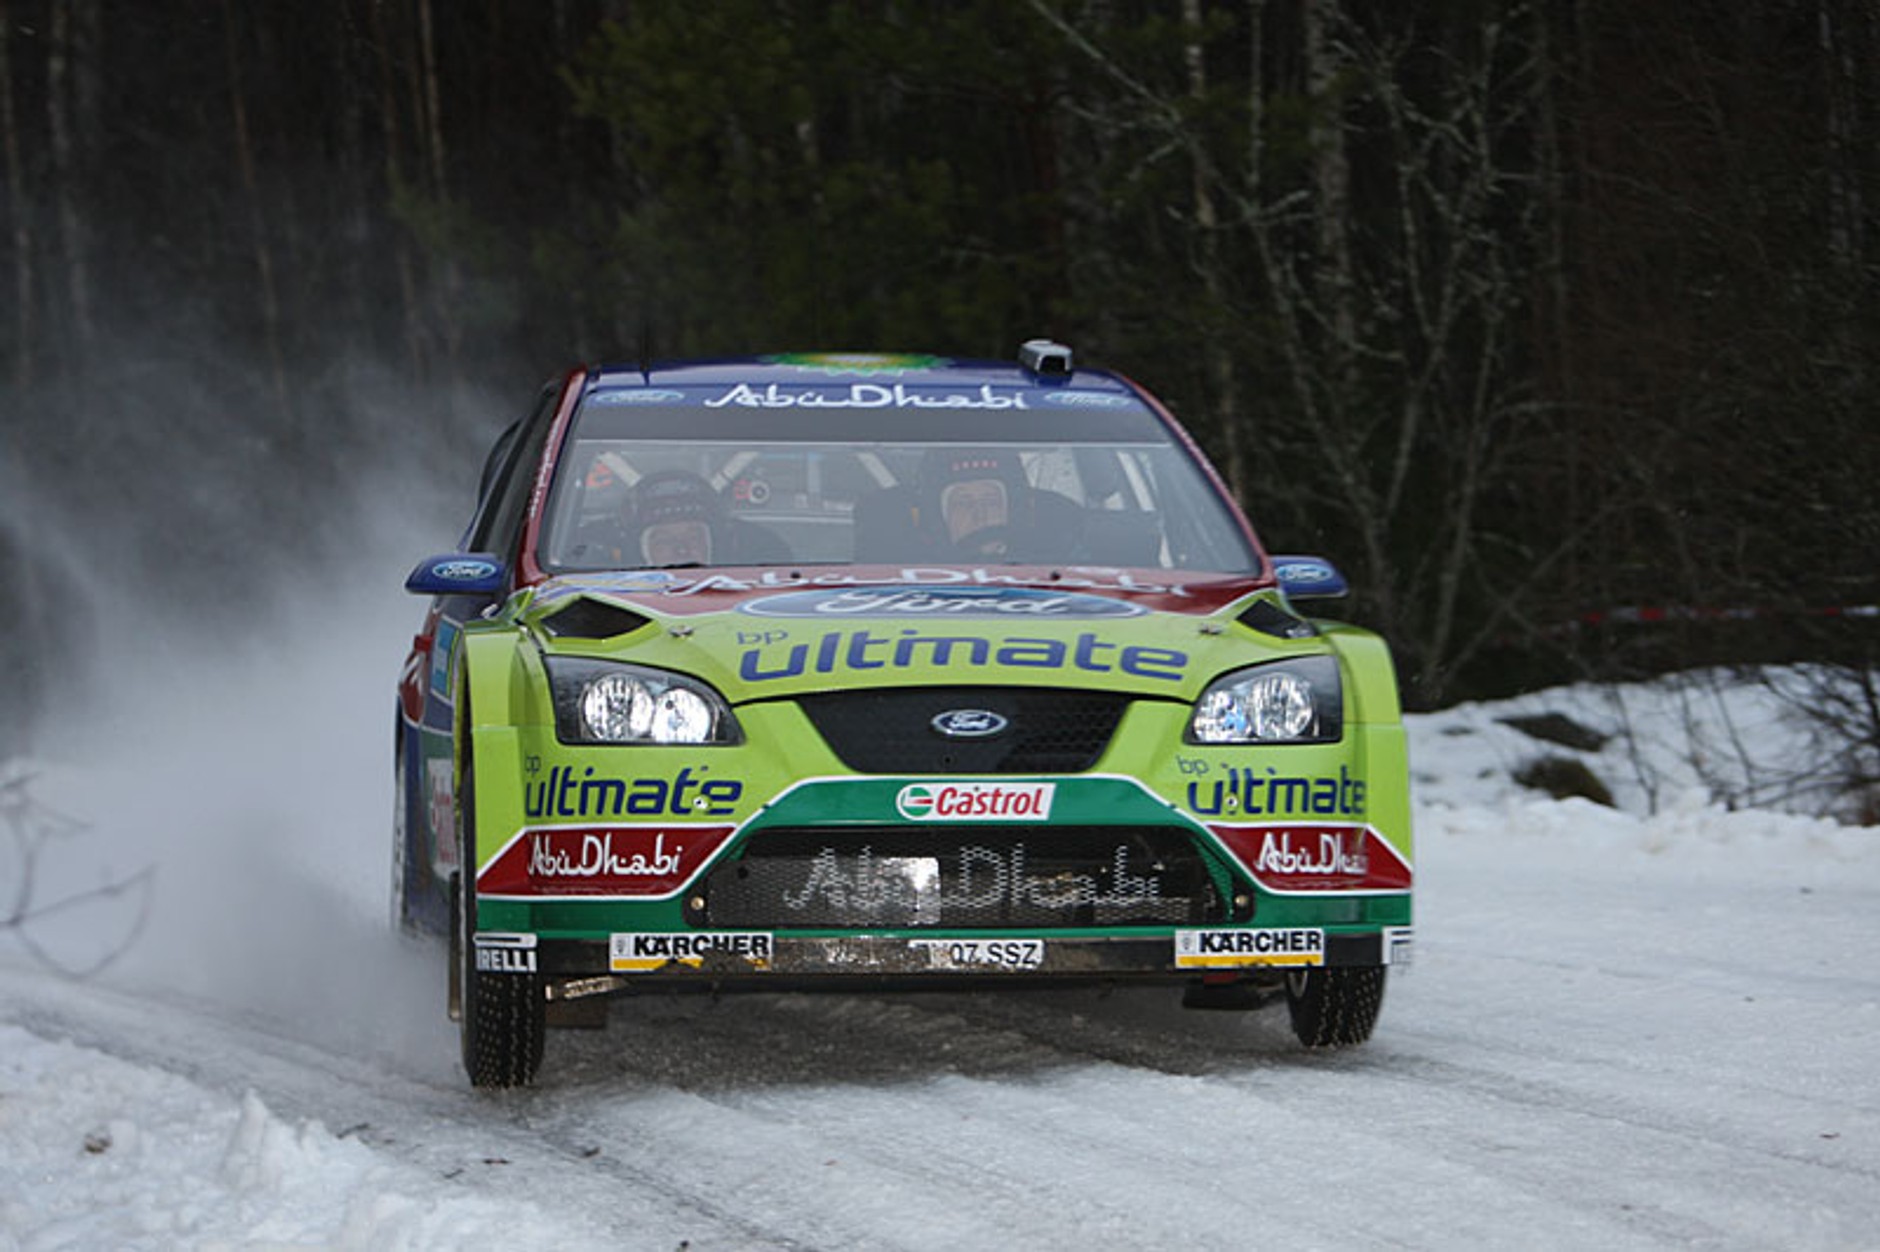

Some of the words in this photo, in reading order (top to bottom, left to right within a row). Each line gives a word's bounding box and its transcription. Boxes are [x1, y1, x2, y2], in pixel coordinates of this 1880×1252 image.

[816, 590, 1072, 613] Ford
[739, 629, 1189, 682] ultimate
[1177, 755, 1209, 776] bp
[525, 766, 744, 817] ultimate
[936, 787, 1043, 816] Castrol
[986, 942, 1039, 965] SSZ
